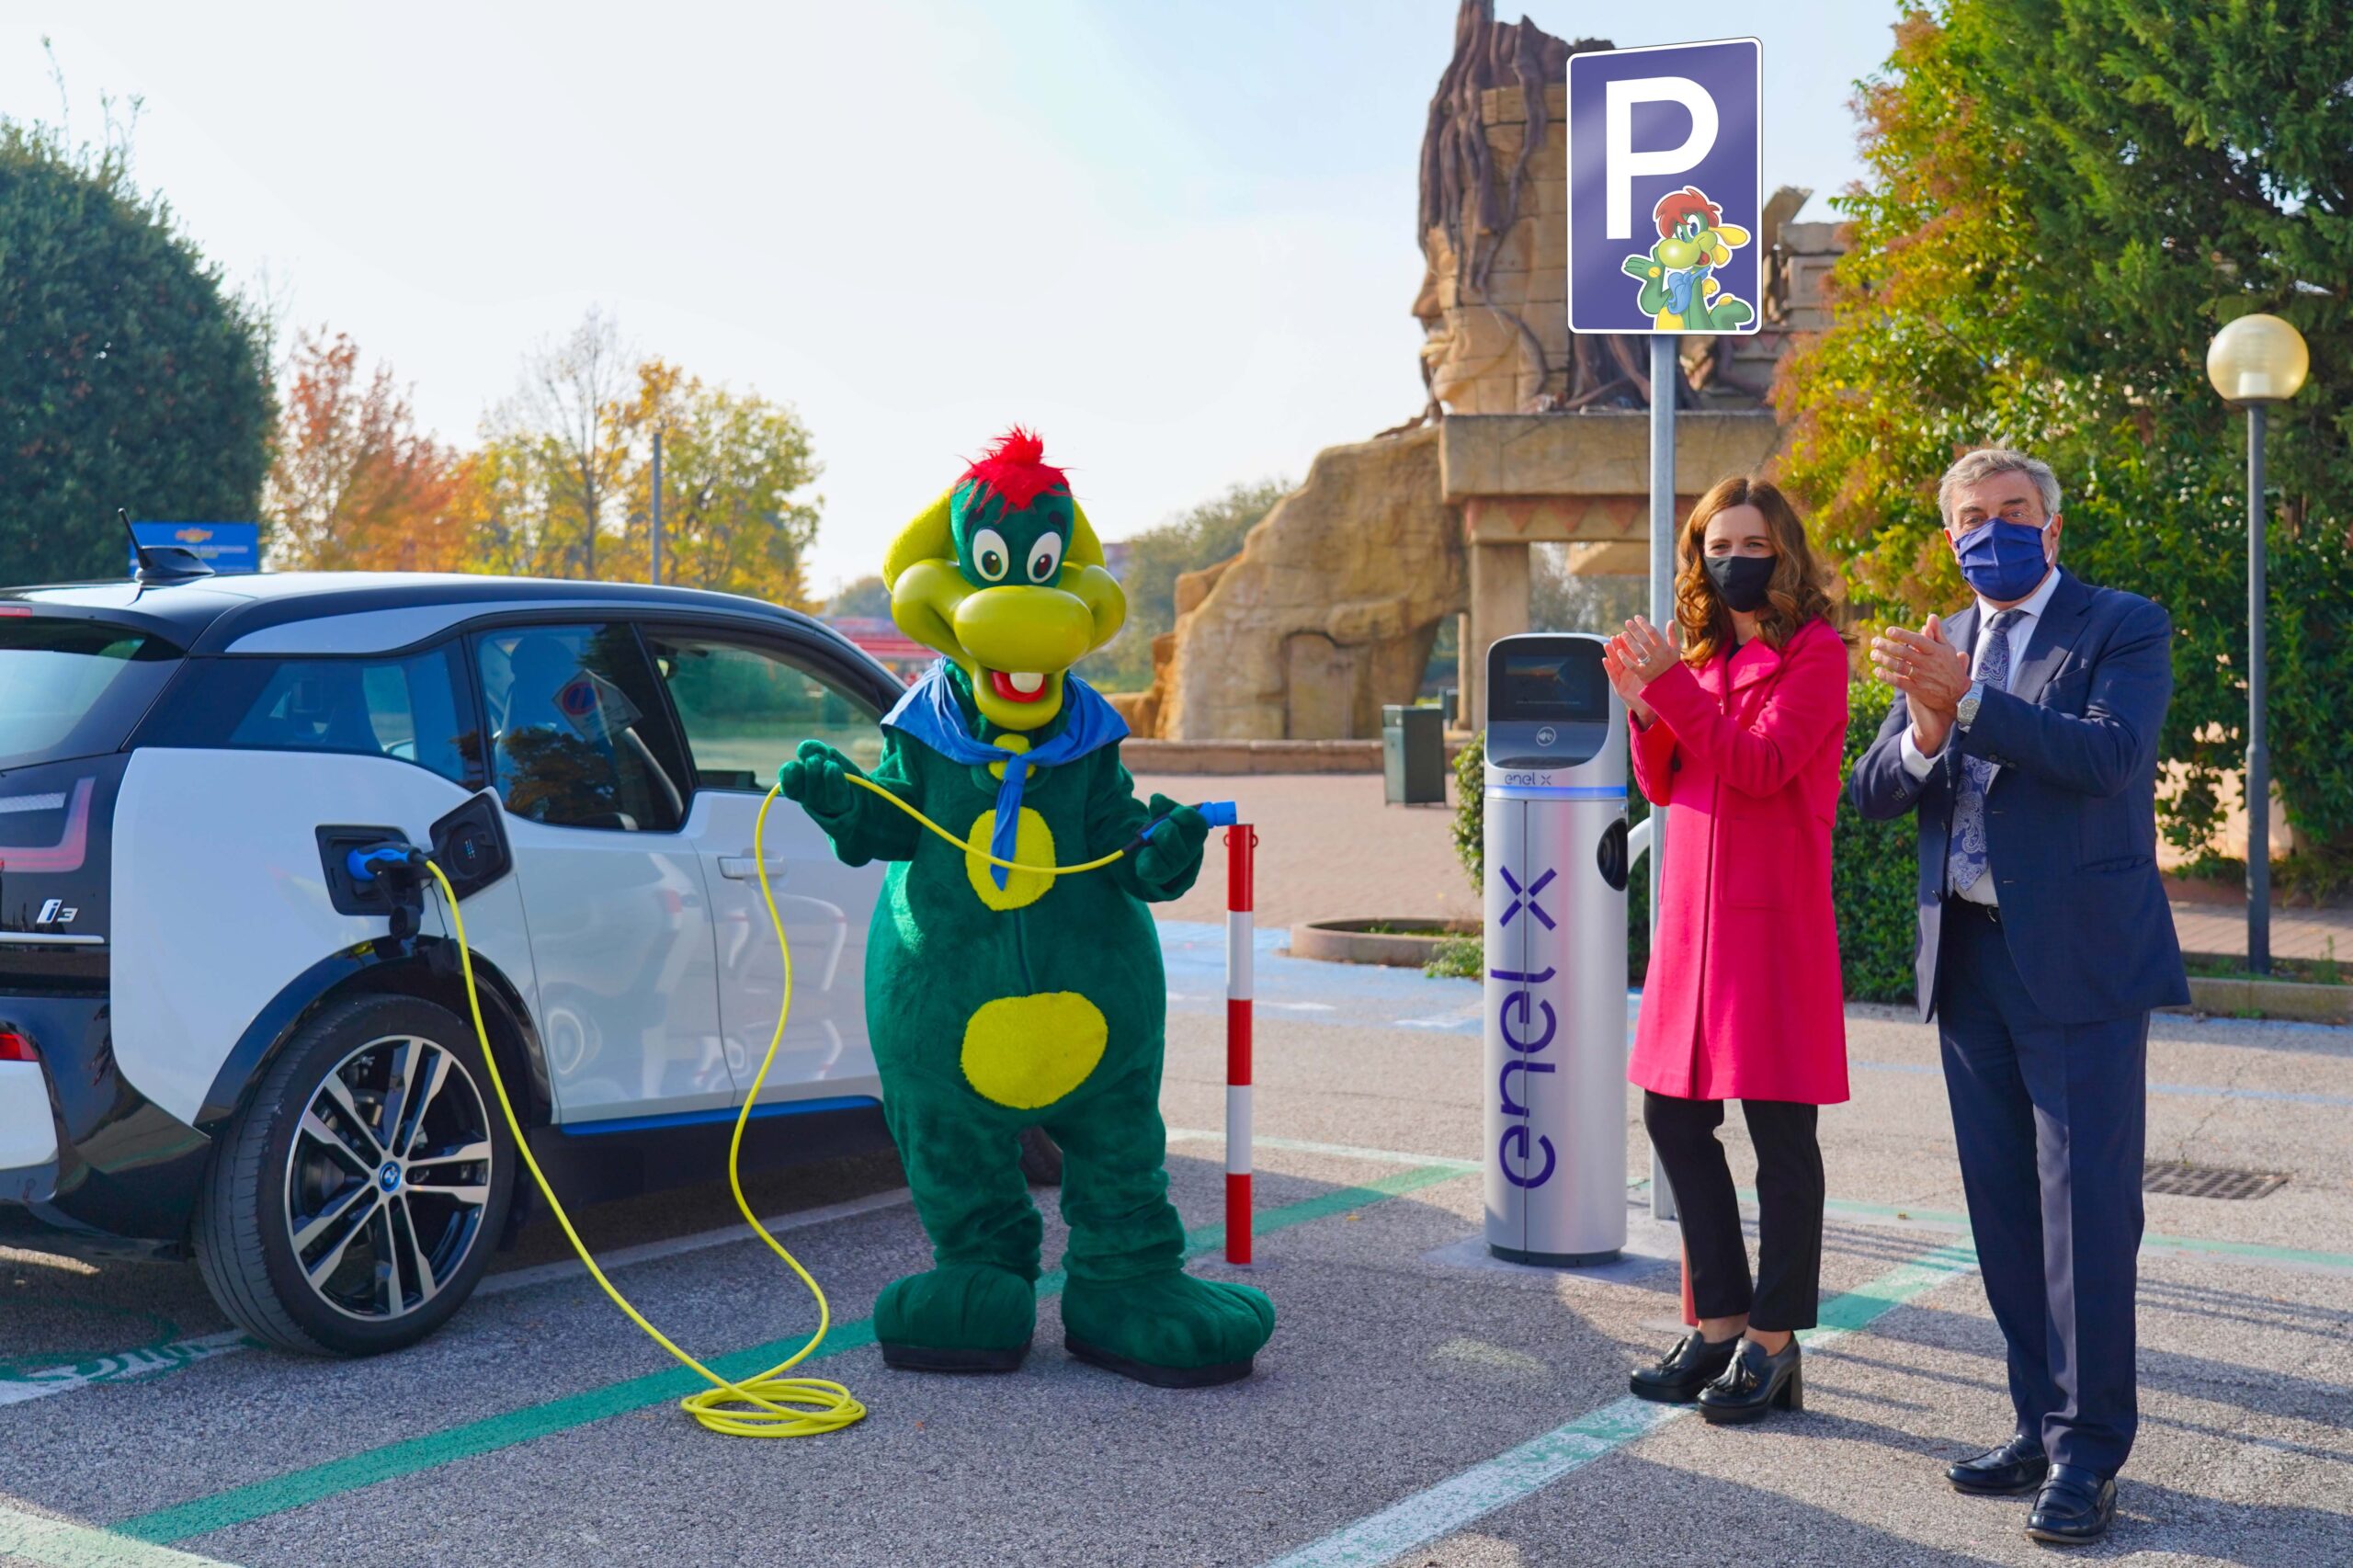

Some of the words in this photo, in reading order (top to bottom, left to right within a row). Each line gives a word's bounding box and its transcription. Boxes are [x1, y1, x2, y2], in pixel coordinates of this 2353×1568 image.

[1607, 76, 1719, 240] P
[1505, 772, 1535, 786] enel
[37, 899, 78, 924] i3
[1490, 966, 1557, 1189] enel
